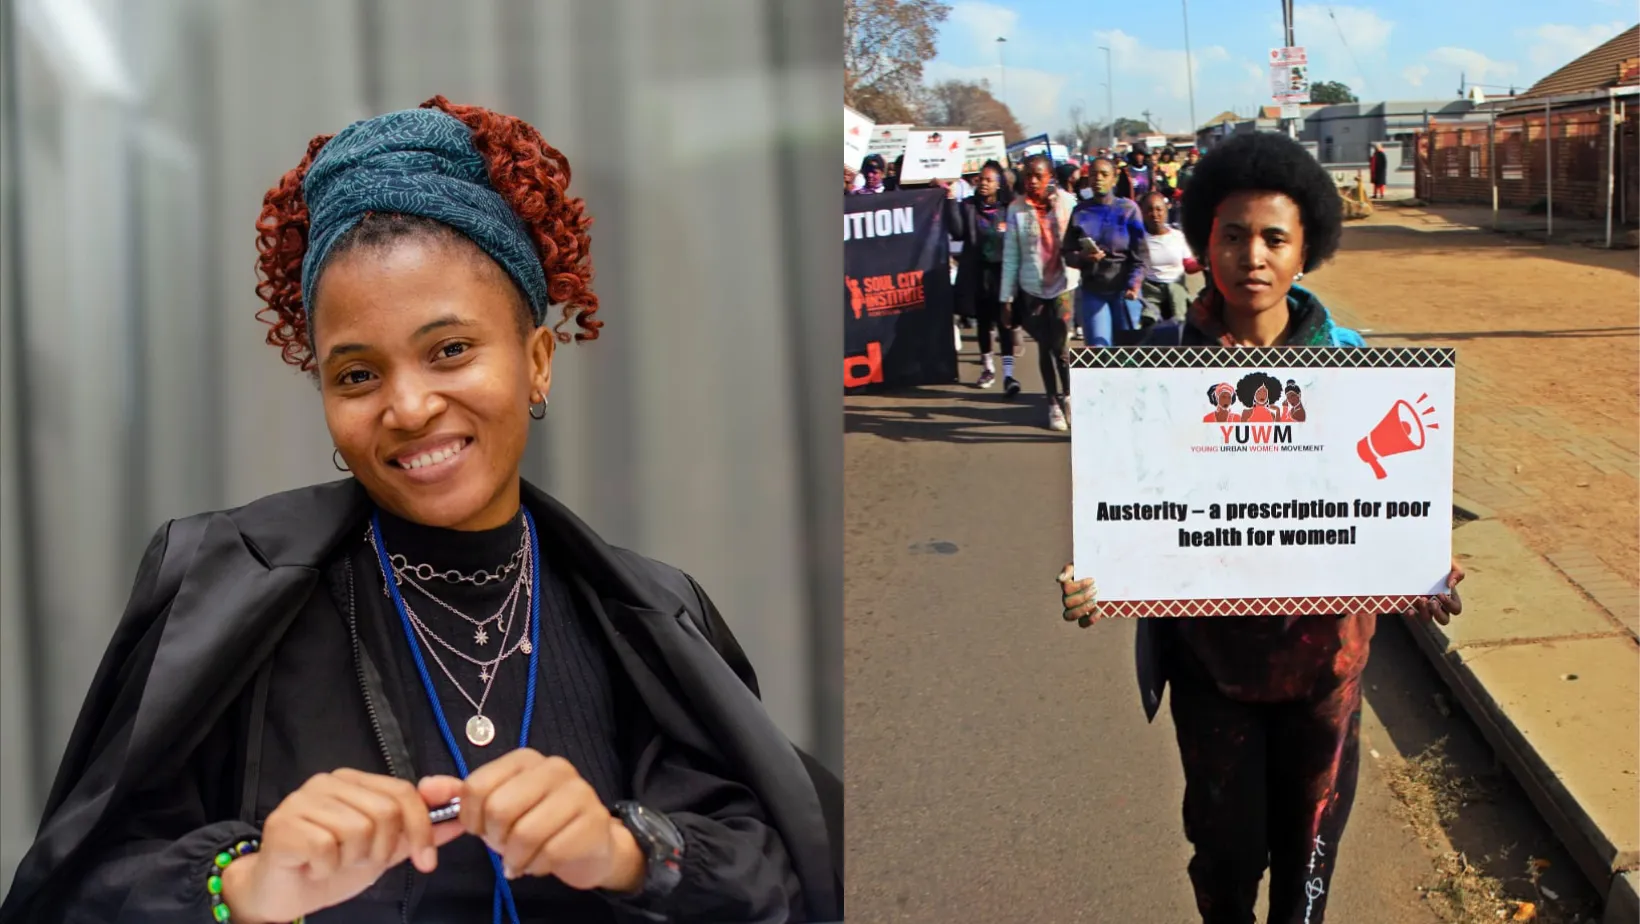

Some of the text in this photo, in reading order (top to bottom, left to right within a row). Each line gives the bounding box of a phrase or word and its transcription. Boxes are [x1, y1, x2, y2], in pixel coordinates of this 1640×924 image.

[863, 270, 924, 293] SOUL CITY
[865, 285, 925, 308] INSTITUTE
[1220, 425, 1292, 444] YUWM
[1191, 444, 1325, 453] YOUNG URBAN WOMEN MOVEMENT
[1097, 501, 1188, 522] Austerity
[1209, 503, 1221, 519] a
[1226, 499, 1348, 521] prescription
[1354, 499, 1382, 518] for
[1386, 500, 1431, 520] poor
[1179, 526, 1356, 547] health for women!
